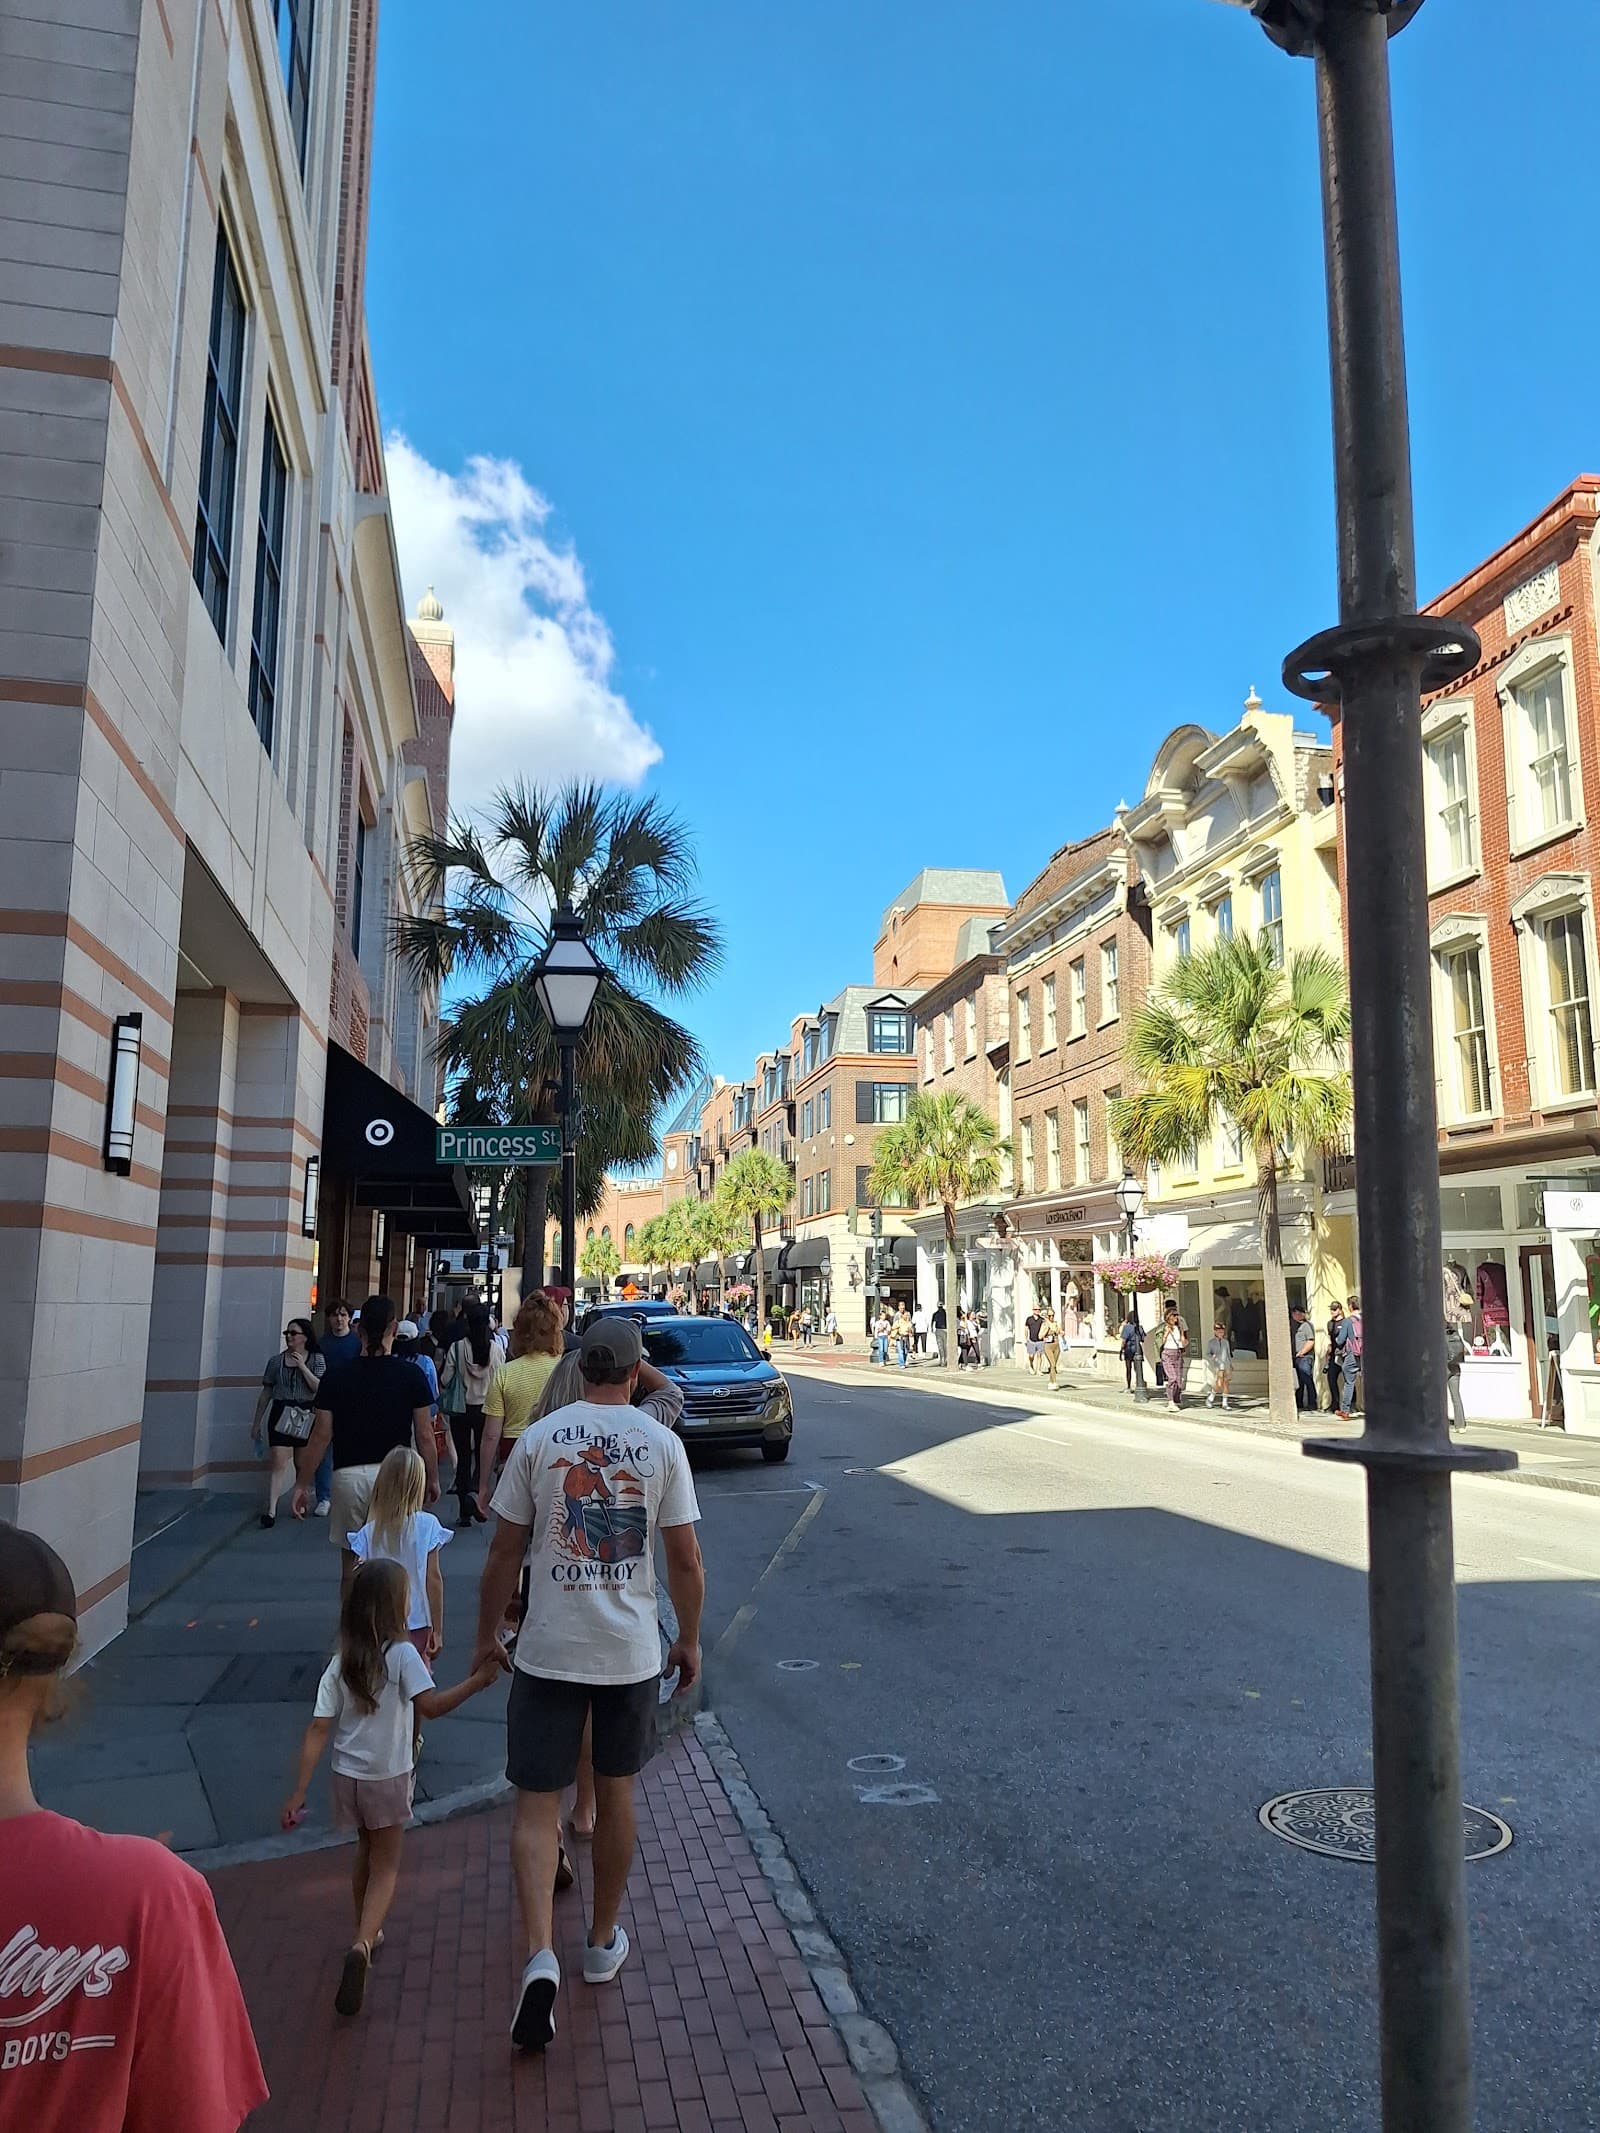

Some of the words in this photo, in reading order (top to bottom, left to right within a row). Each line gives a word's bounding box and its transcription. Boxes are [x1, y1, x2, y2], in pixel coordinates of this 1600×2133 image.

[440, 1131, 537, 1158] Princess
[541, 1130, 556, 1146] St
[552, 1424, 593, 1446] CUL
[1, 2031, 71, 2070] BOYS
